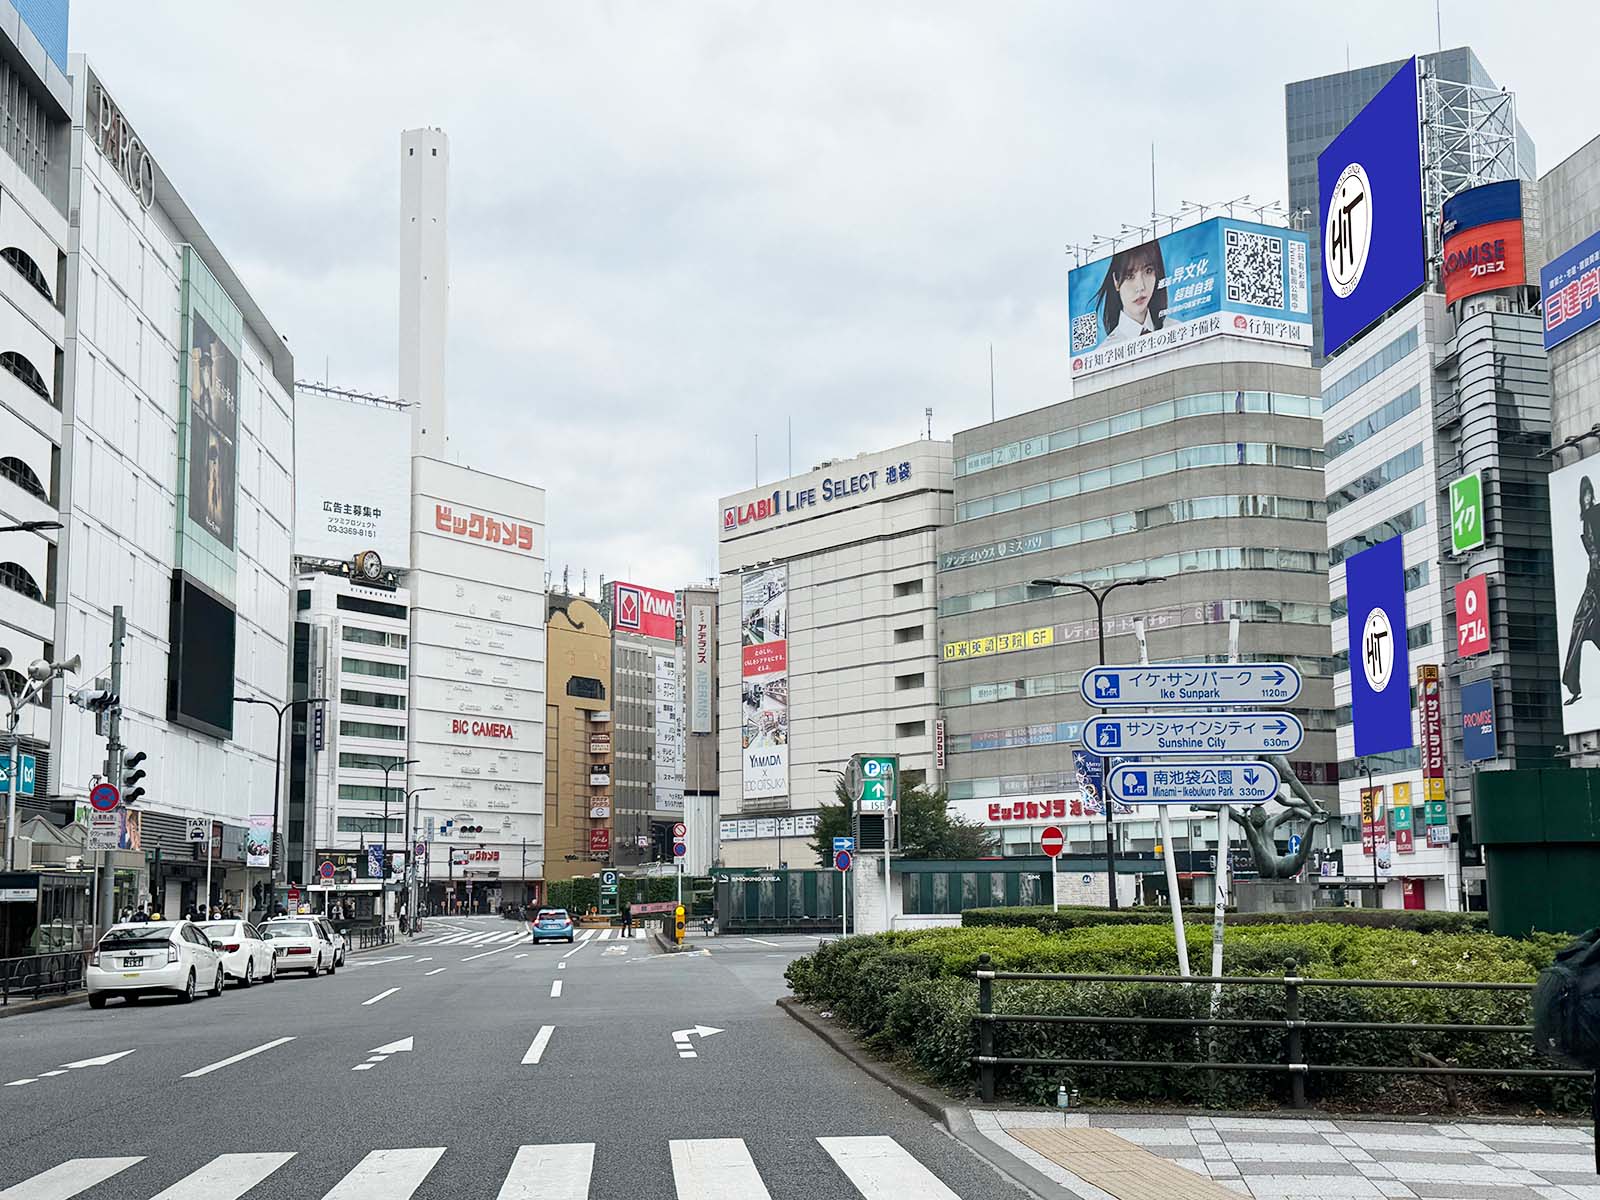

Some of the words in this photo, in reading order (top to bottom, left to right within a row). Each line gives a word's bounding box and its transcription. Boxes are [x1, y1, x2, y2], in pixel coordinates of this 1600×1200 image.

[93, 84, 155, 210] PARCO
[1442, 238, 1505, 276] OMISE
[1470, 260, 1505, 278] プロミス
[1544, 267, 1600, 331] 日建学
[1250, 317, 1300, 340] 行知学園
[1084, 343, 1124, 370] 行知学園
[885, 462, 912, 485] 池袋
[323, 501, 381, 518] 広告主募集中
[1453, 487, 1475, 536] レイク
[435, 504, 533, 550] ビックカメラ
[640, 590, 675, 618] YAMA
[1032, 631, 1046, 645] 6F
[1459, 618, 1486, 646] アコム
[697, 624, 707, 664] アデランス
[1160, 689, 1175, 698] Ike
[1179, 687, 1220, 700] Sunpark
[1262, 689, 1288, 697] 1120m
[452, 719, 469, 735] BIC
[472, 721, 513, 740] CAMERA
[1126, 721, 1256, 737] サンシャインシティ
[1463, 709, 1492, 728] PROMISE
[1158, 736, 1203, 748] Sunshine
[1207, 736, 1226, 750] City
[1263, 738, 1290, 747] 630m
[1427, 699, 1441, 768] サンドラッグ
[749, 754, 781, 768] YAMADA
[1153, 769, 1233, 786] 南池袋公園
[1152, 786, 1216, 797] Minami-Ikebukuro
[1218, 786, 1234, 797] Park
[1239, 788, 1266, 797] 330m
[988, 799, 1066, 822] ビックカメラ
